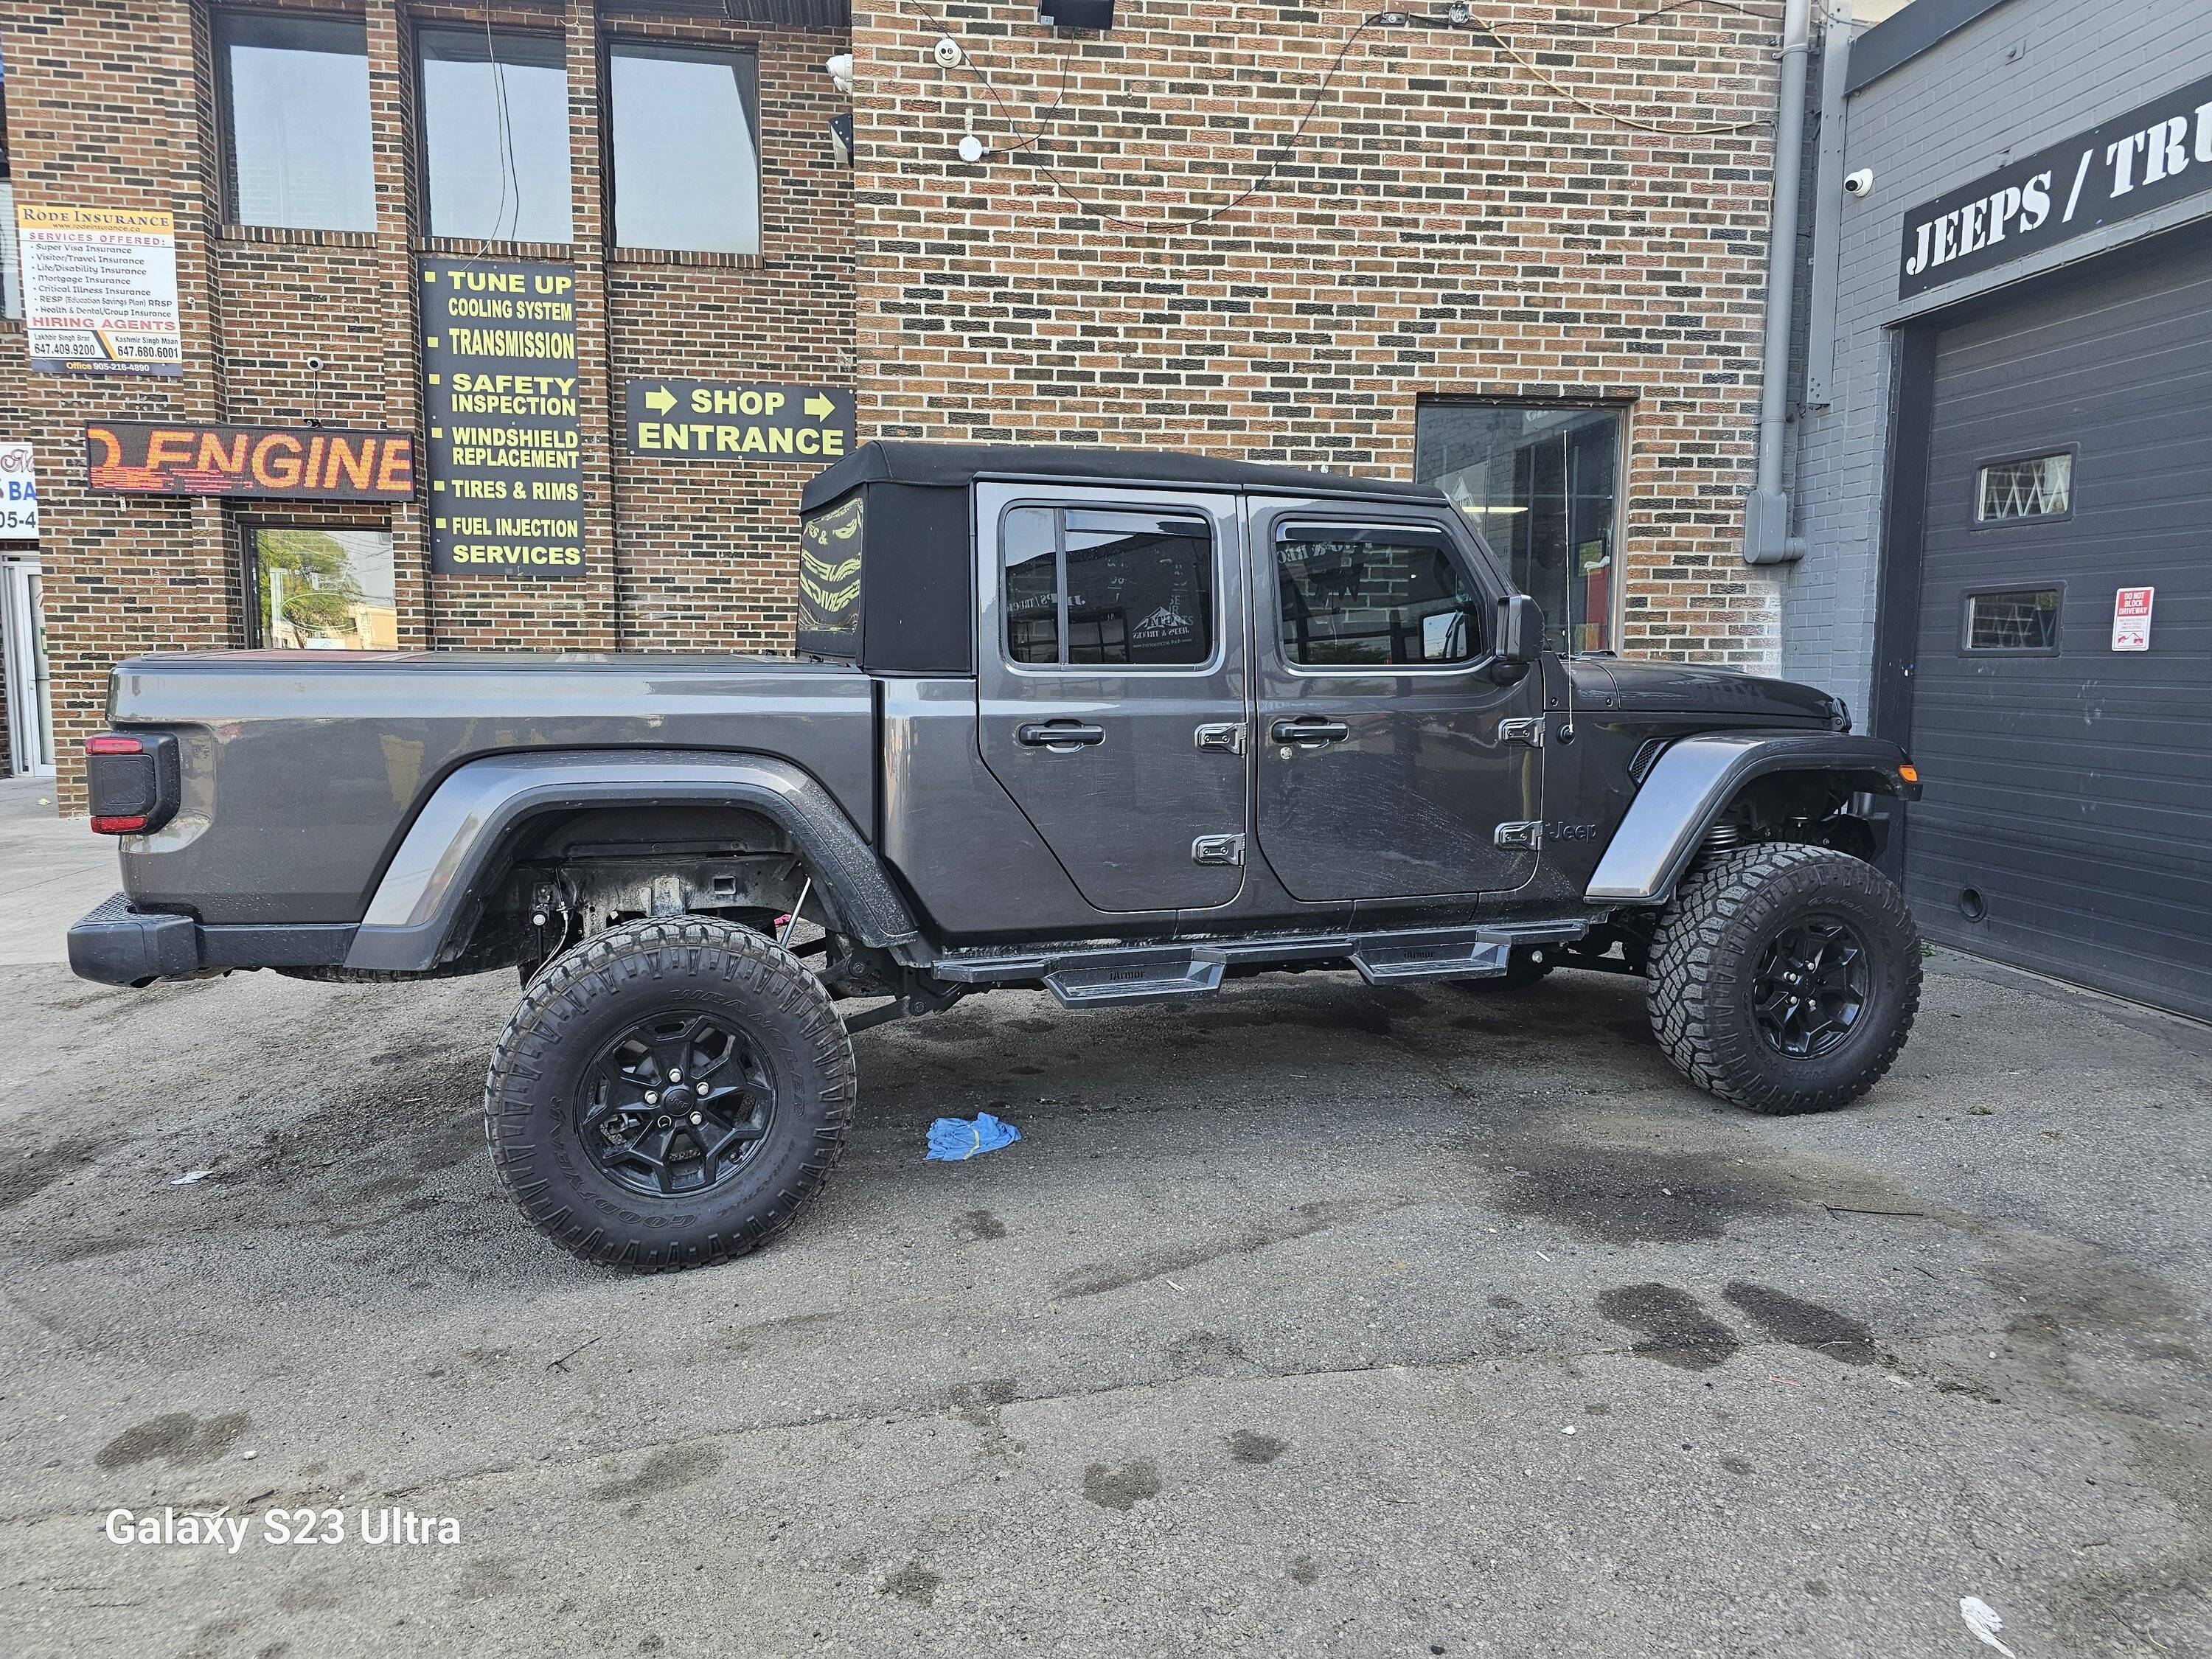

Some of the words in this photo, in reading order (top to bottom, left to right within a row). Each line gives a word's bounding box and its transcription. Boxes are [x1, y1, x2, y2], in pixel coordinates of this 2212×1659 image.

[1906, 170, 2051, 276] JEEPS
[2062, 149, 2093, 223] /
[52, 223, 140, 232] www.rodeinsurance.ca
[29, 232, 93, 241] SERVICES
[100, 235, 164, 246] OFFERED:
[35, 243, 60, 251] Super
[86, 245, 132, 254] Insurance
[36, 254, 96, 262] Visitor/Travel
[98, 256, 145, 265] Insurance
[37, 264, 98, 274] Life/Disability
[101, 266, 147, 275] Insurance
[85, 276, 131, 285] Insurance
[448, 271, 525, 293] TUNE
[535, 275, 571, 295] UP
[38, 285, 71, 293] Critical
[73, 285, 102, 293] Illness
[105, 288, 151, 296] Insurance
[102, 297, 127, 307] Savings
[129, 299, 146, 307] Plan)
[76, 307, 128, 316] Dental/Group
[448, 297, 512, 318] COOLING
[516, 301, 572, 321] SYSTEM
[32, 317, 94, 327] HIRING
[101, 319, 176, 330] AGENTS
[142, 336, 160, 345] Singh
[448, 327, 575, 359] TRANSMISSION
[35, 344, 95, 355] 647.409.9200
[117, 346, 178, 358] 647.680.6001
[66, 361, 91, 369] Office
[92, 362, 150, 372] 905-216-4890
[452, 373, 576, 396] SAFETY
[451, 394, 577, 417] INSPECTION
[691, 389, 785, 416] SHOP
[451, 426, 578, 448] WINDSHIELD
[638, 422, 844, 456] ENTRANCE
[452, 447, 579, 469] REPLACEMENT
[451, 479, 507, 499] TIRES
[512, 481, 526, 500] &
[532, 481, 579, 501] RIMS
[452, 517, 492, 535] FUEL
[495, 518, 578, 538] INJECTION
[453, 545, 581, 566] SERVICES
[2124, 592, 2133, 600] DO
[2133, 591, 2145, 599] NOT
[2124, 599, 2143, 608] BLOCK
[2118, 607, 2148, 615] DRIVEWAY
[1549, 821, 1596, 843] Jeep
[1110, 970, 1145, 981] iArmor
[669, 987, 806, 1117] WRANGLER
[548, 1096, 697, 1228] GOODYEAR
